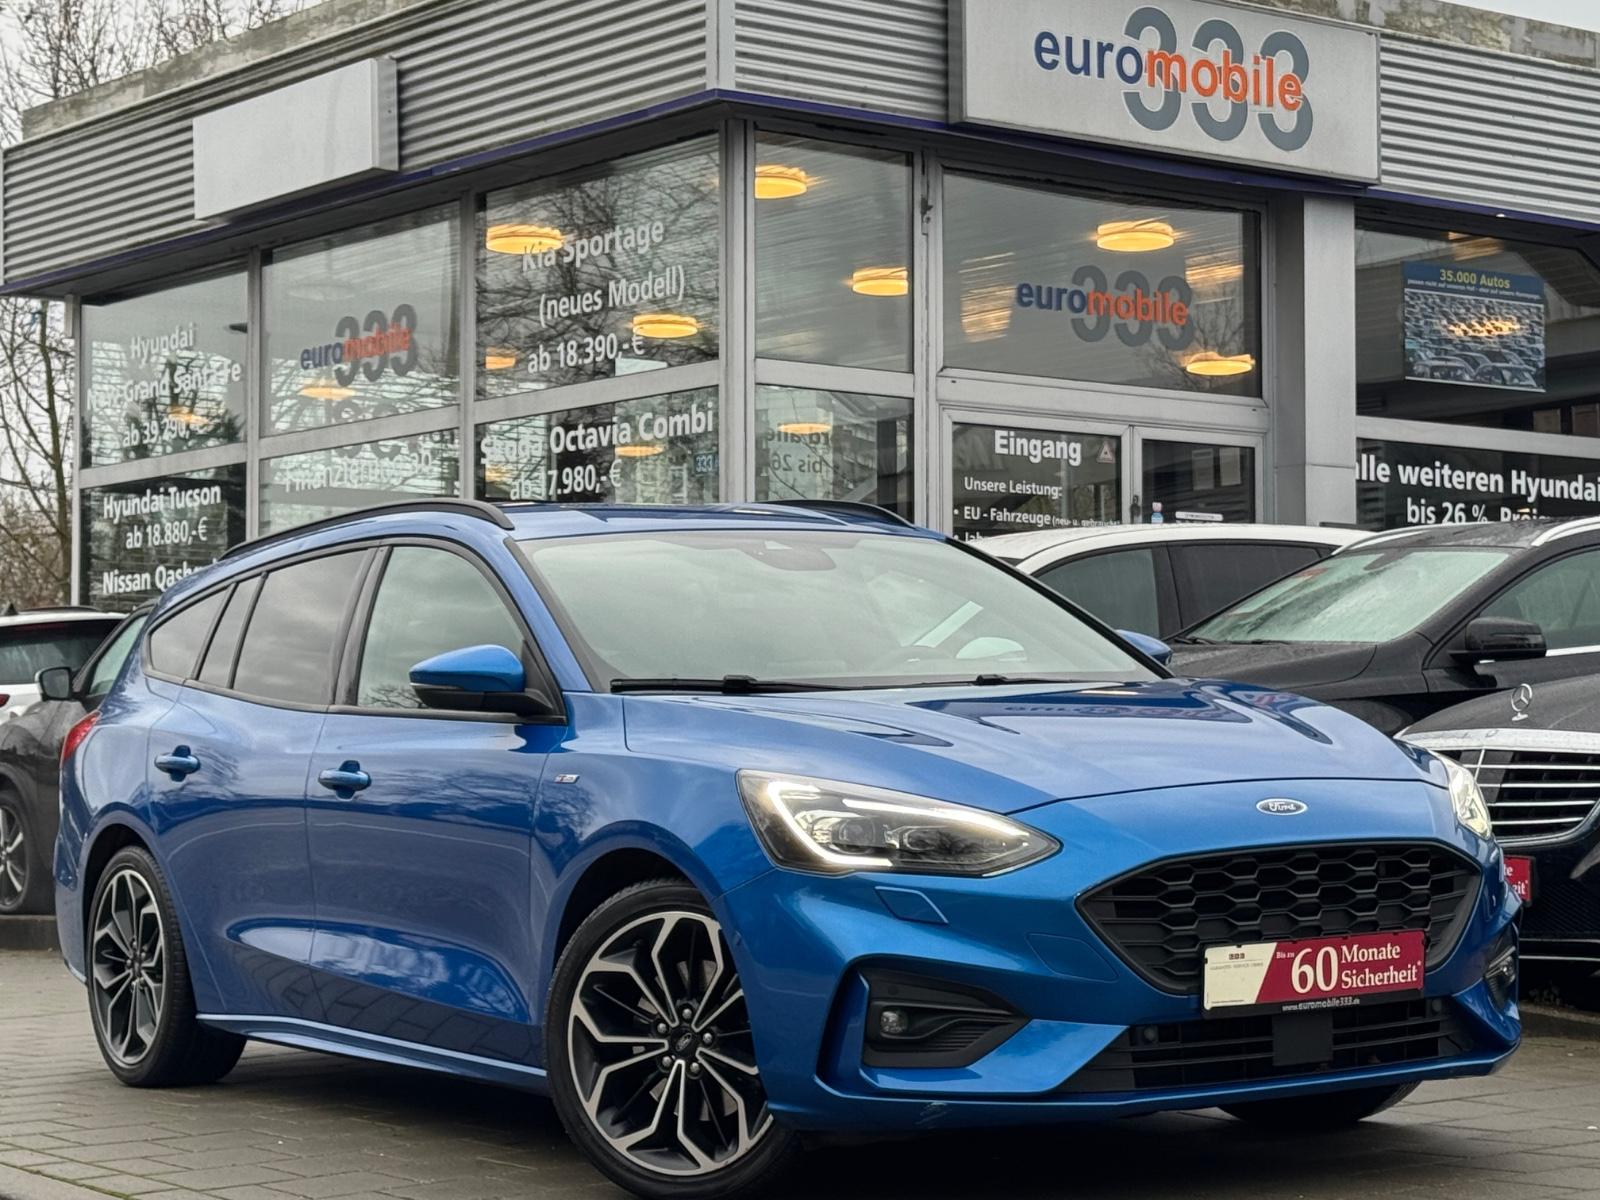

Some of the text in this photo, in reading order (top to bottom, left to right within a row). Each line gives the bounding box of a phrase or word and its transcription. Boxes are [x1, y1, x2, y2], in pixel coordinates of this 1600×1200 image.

[522, 221, 664, 272] Kia Sportage
[1440, 269, 1477, 285] 35.000
[1480, 274, 1511, 289] Autos
[539, 265, 685, 328] (neues Modell)
[130, 323, 194, 369] Hyundai
[527, 344, 551, 374] ab
[124, 368, 170, 402] Grand
[122, 423, 141, 447] ab
[550, 416, 631, 454] Octavia
[638, 402, 714, 440] Combi
[994, 429, 1081, 466] Eingang
[964, 477, 1063, 499] Unsere Leistung:
[1397, 461, 1504, 493] weiteren
[103, 485, 222, 524] Hyundai Tucson
[964, 506, 981, 520] EU
[990, 509, 1051, 527] Fahrzeuge
[1406, 497, 1436, 524] bis
[1442, 502, 1466, 524] 26
[126, 525, 143, 549] ab
[103, 569, 151, 596] Nissan
[1268, 801, 1297, 812] Ford
[1291, 946, 1339, 994] 60
[1340, 942, 1401, 964] Monate
